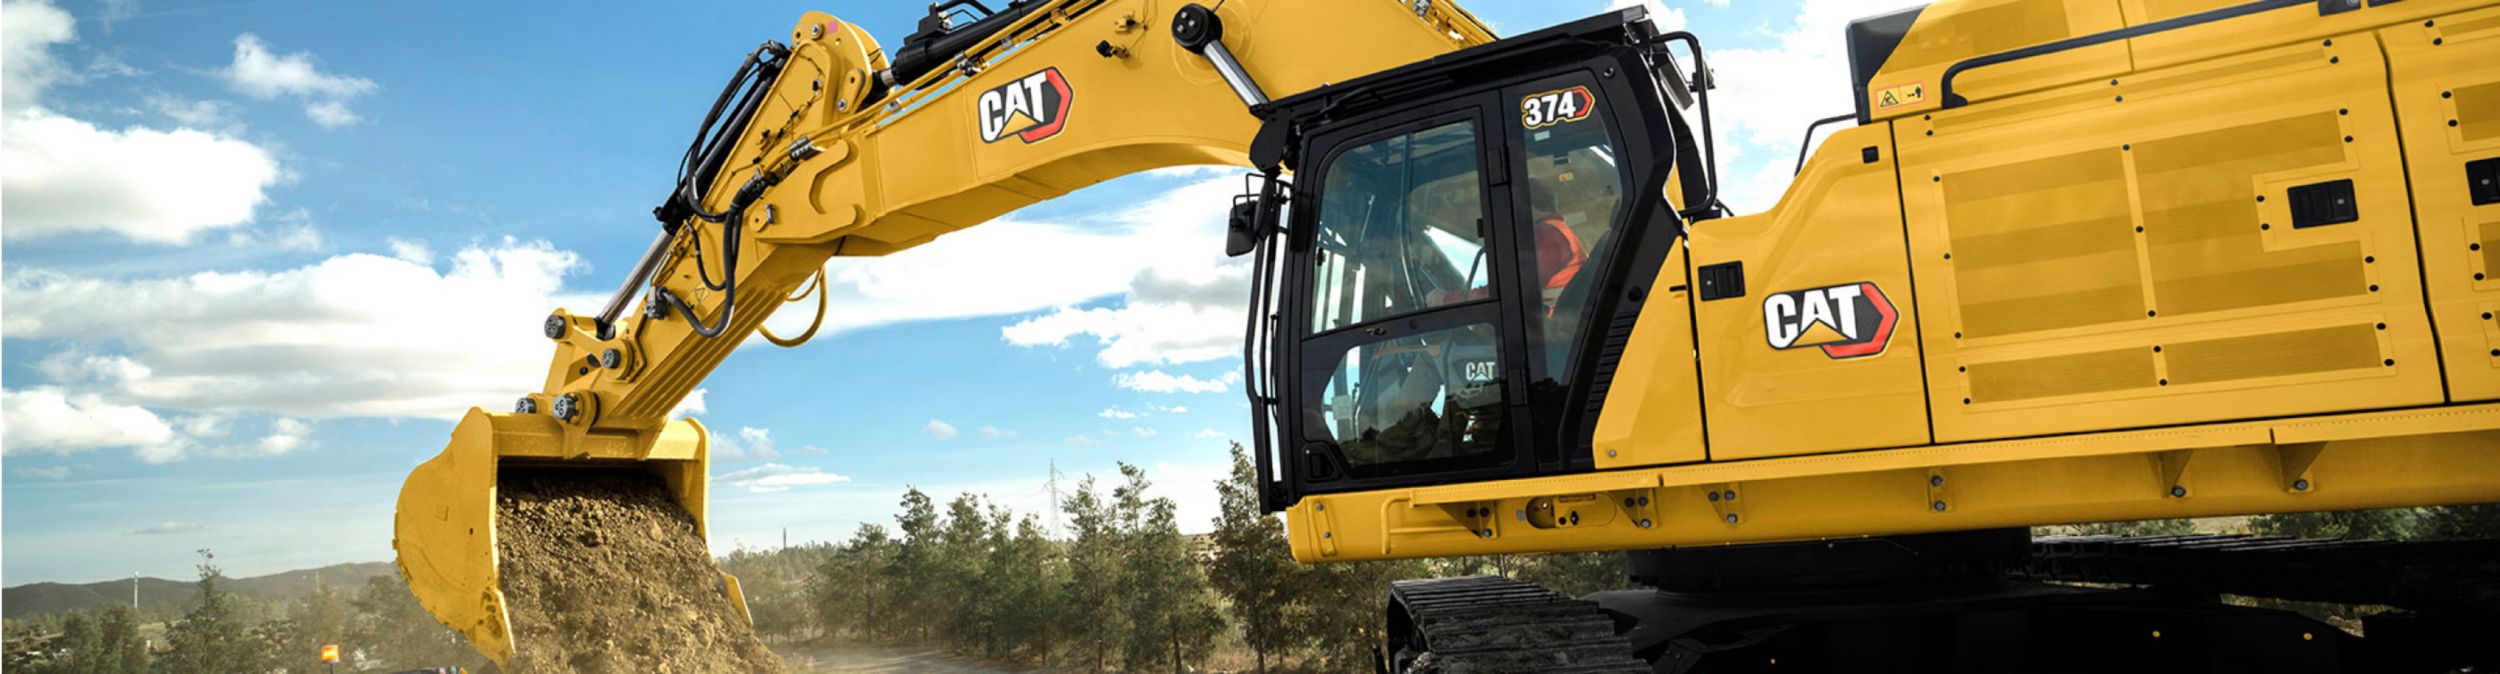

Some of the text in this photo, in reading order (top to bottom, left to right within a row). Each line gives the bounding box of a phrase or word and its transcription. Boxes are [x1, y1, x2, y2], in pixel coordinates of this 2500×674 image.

[979, 71, 1047, 142] CAT
[1523, 90, 1576, 126] 374
[1764, 284, 1861, 349] CAT
[1465, 361, 1496, 381] CAT
